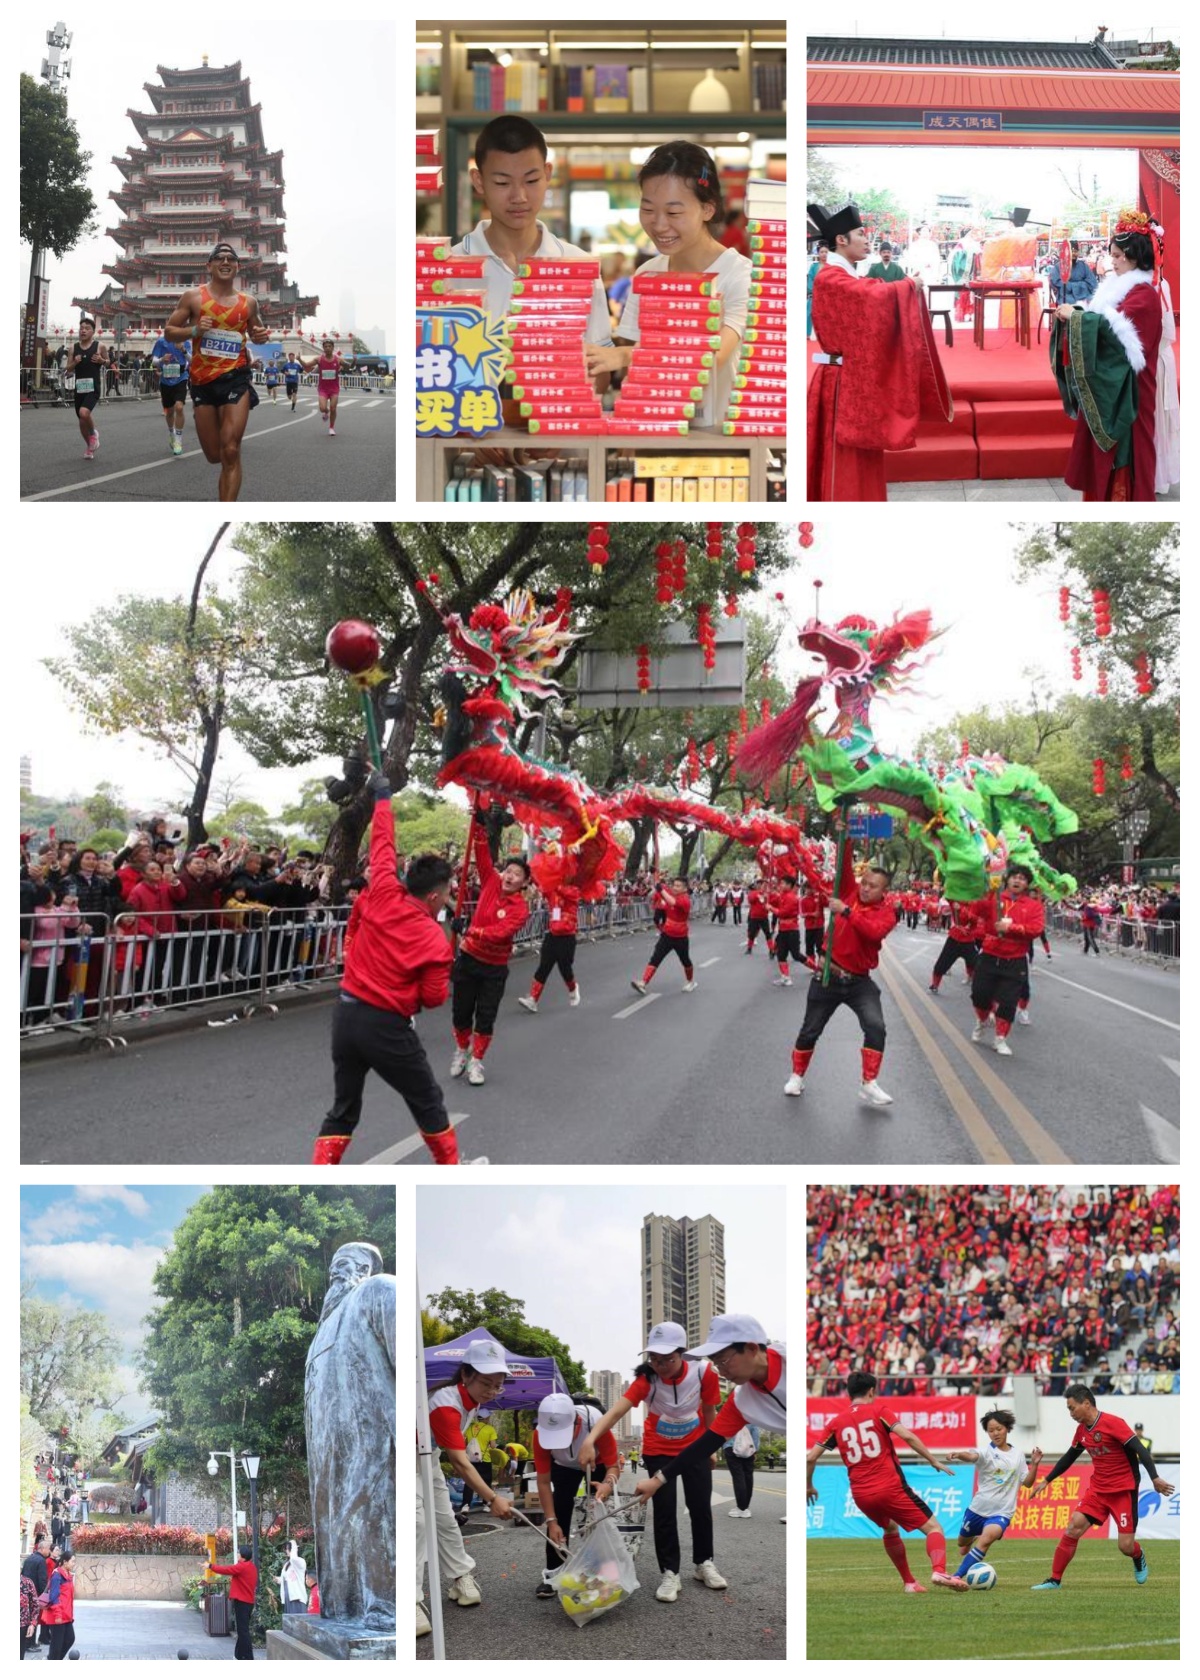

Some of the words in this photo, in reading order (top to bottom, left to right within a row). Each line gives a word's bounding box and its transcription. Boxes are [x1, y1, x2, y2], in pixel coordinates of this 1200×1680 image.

[205, 339, 237, 352] B2171
[416, 348, 453, 388] 书
[416, 390, 499, 432] 买单
[893, 1411, 966, 1429] 圆满成功!
[841, 1419, 881, 1464] 35
[1120, 1513, 1127, 1527] 5
